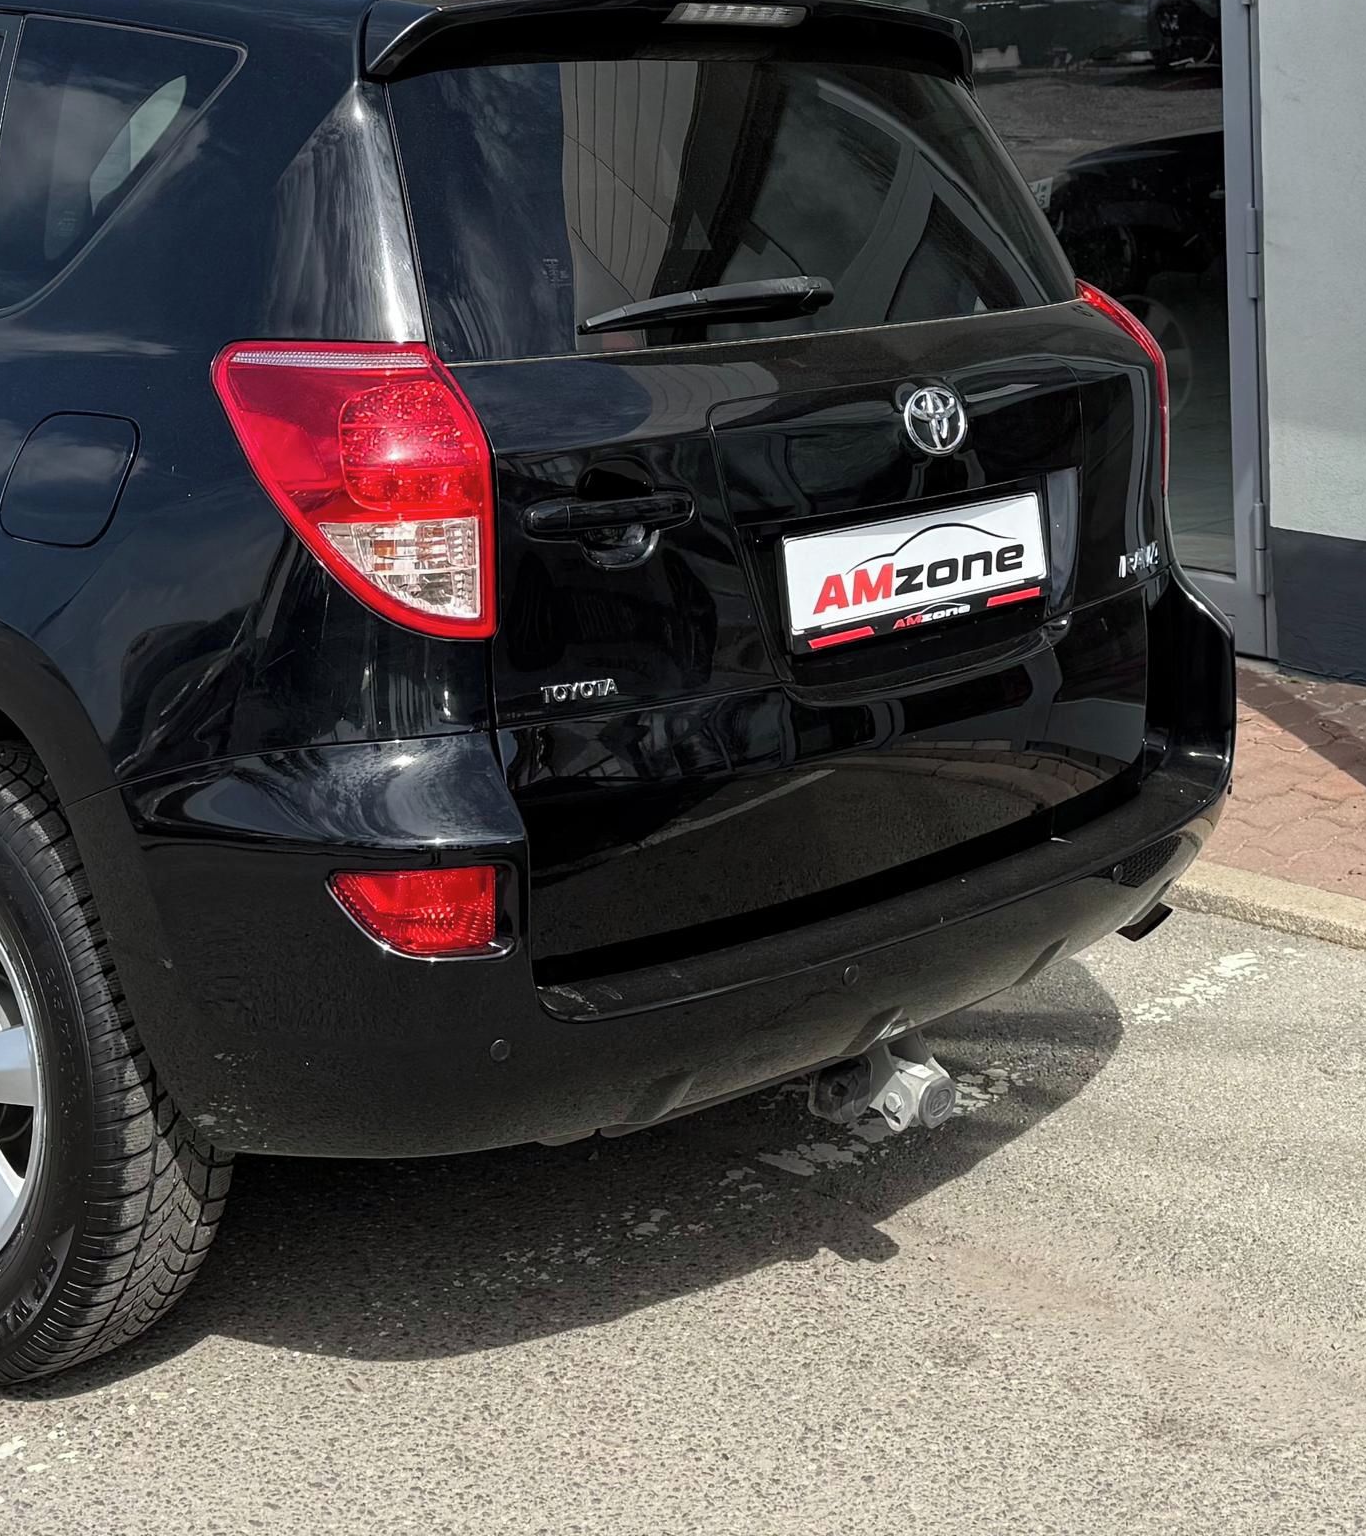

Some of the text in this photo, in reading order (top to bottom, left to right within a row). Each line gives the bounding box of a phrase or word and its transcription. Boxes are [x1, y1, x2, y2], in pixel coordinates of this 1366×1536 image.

[813, 544, 1025, 615] AMzone
[893, 604, 971, 630] AMzone
[540, 678, 619, 704] TOYOTA
